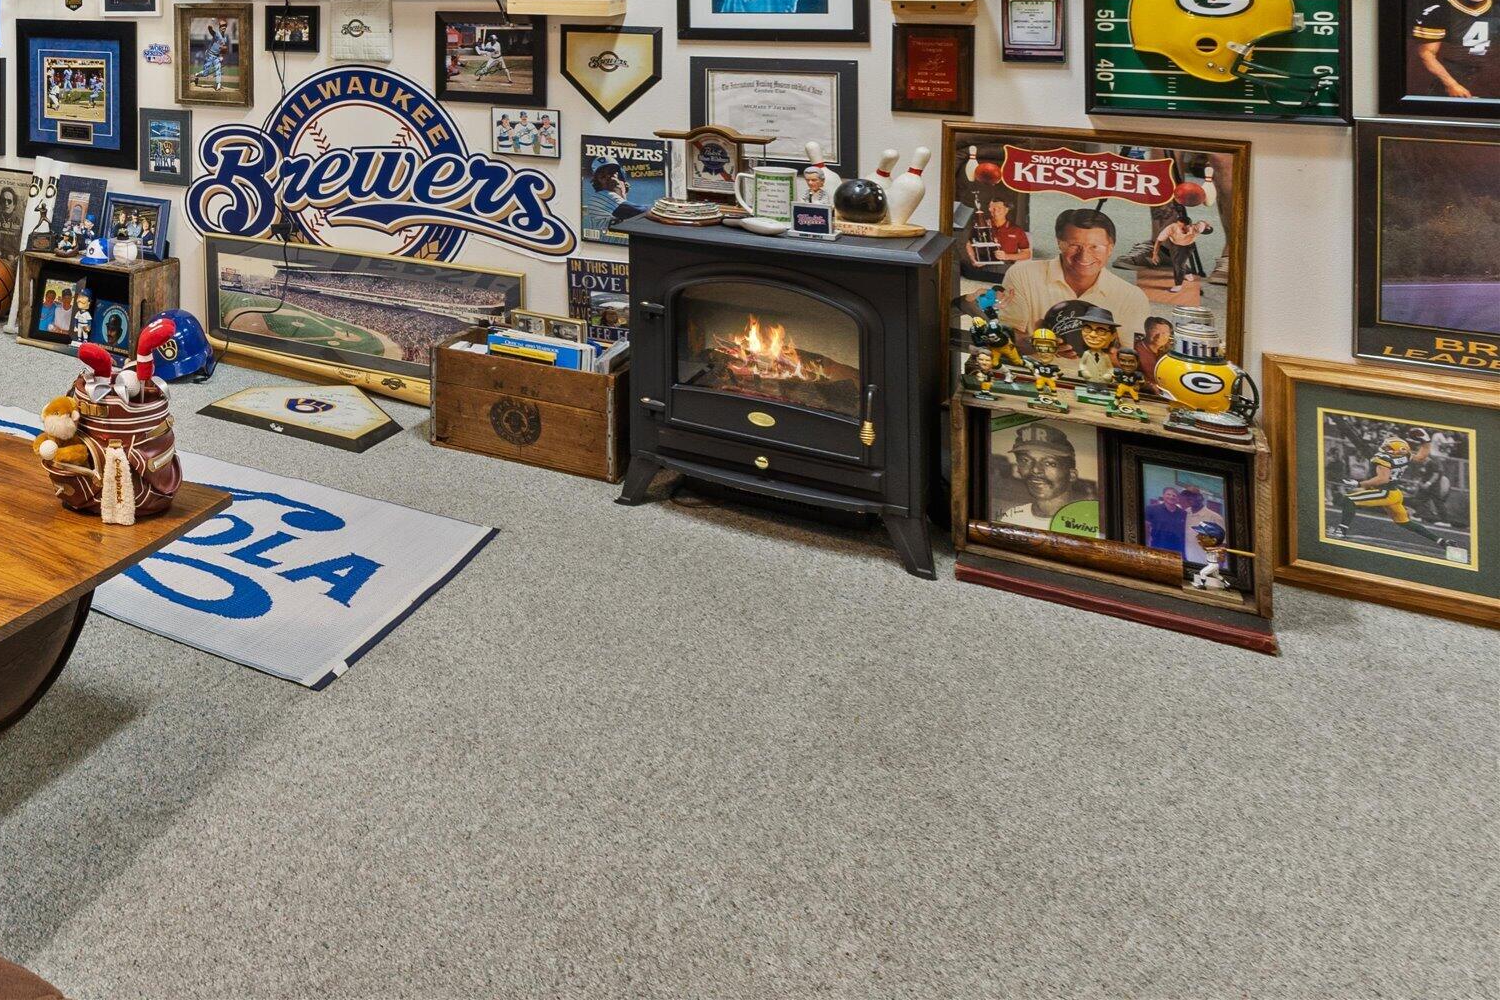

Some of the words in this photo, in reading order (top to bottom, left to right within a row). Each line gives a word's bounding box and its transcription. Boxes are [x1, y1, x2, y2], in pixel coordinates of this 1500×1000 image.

[1097, 9, 1115, 32] 50
[1313, 11, 1335, 36] 50
[1462, 20, 1491, 56] 4
[1097, 58, 1115, 82] 40
[276, 75, 450, 147] MILWAUKEE
[585, 143, 664, 162] BREWERS
[1031, 154, 1087, 168] SMOOTH
[1089, 159, 1109, 170] AS
[1111, 162, 1140, 173] SILK
[186, 124, 564, 243] Brewers
[1013, 162, 1161, 197] KESSLER
[571, 261, 581, 272] IN
[585, 260, 609, 274] THIS
[571, 273, 622, 289] LOVE
